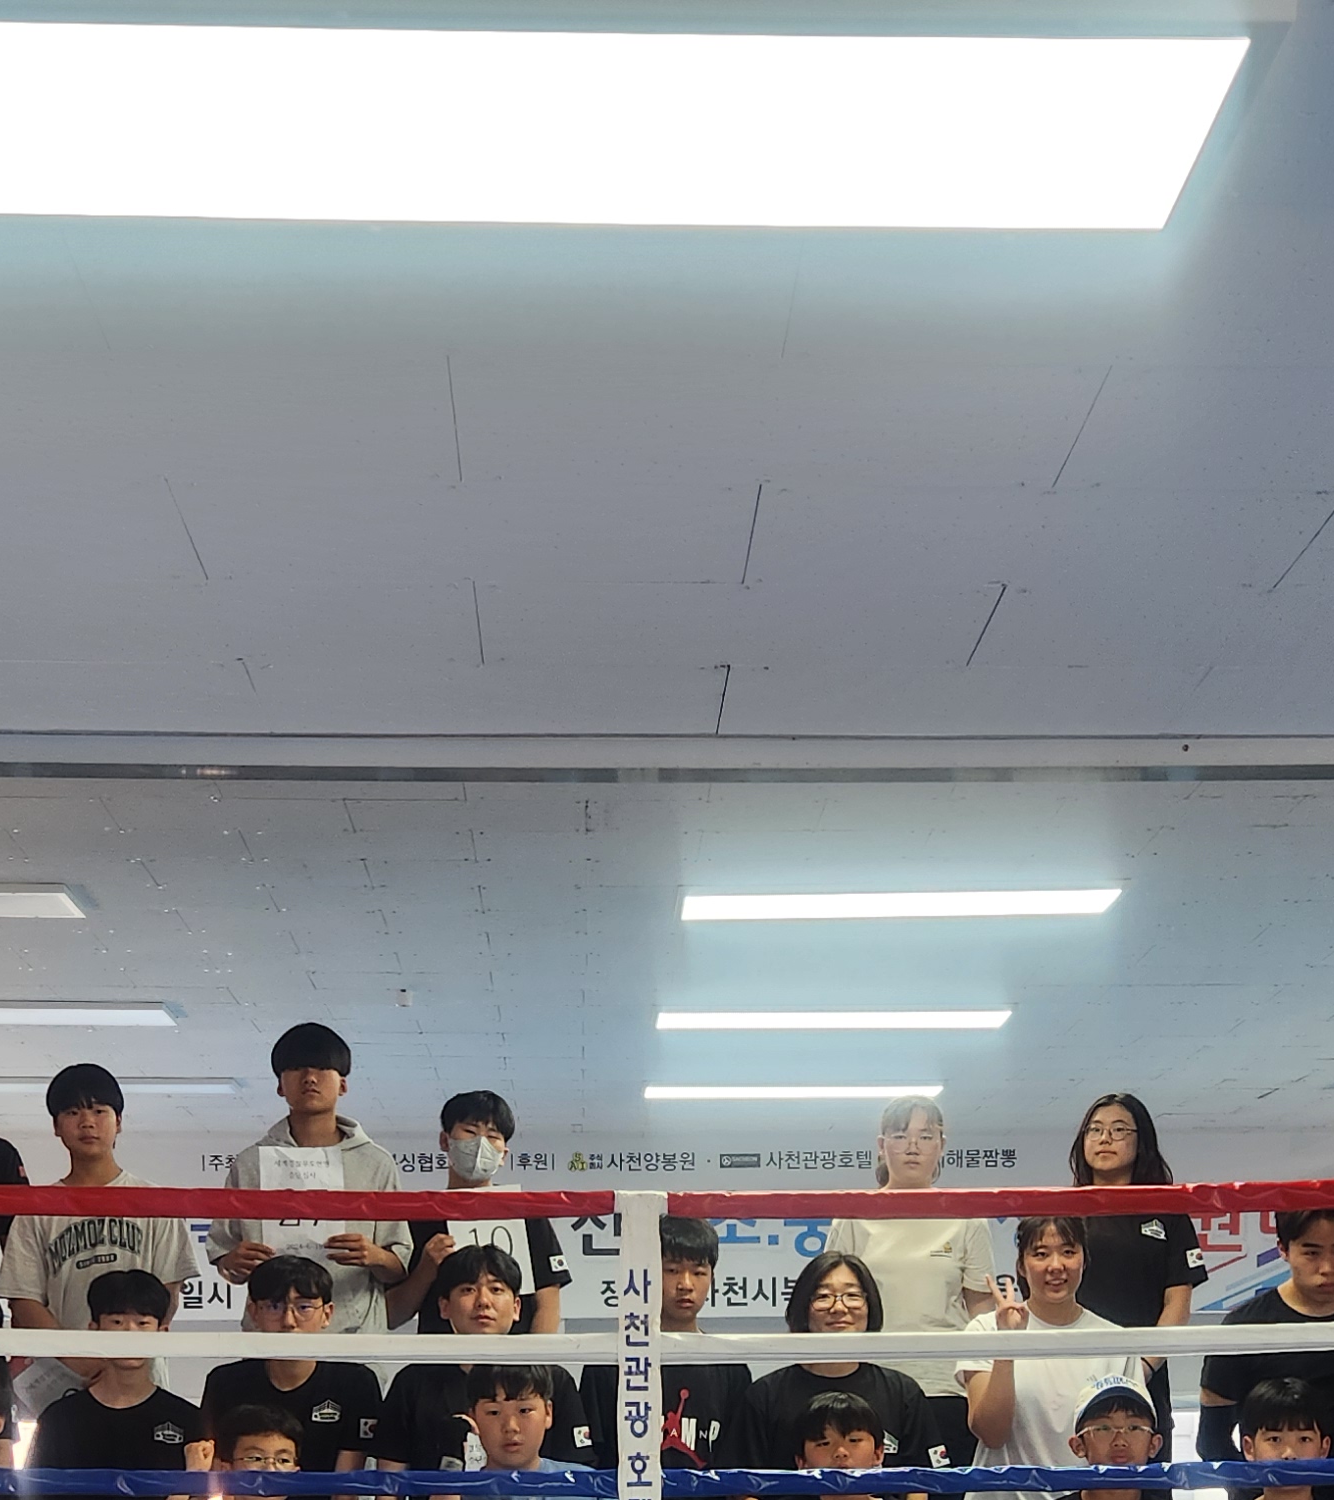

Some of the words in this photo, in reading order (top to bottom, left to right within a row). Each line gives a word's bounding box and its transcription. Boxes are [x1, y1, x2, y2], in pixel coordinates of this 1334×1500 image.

[606, 1151, 696, 1172] 사천양봉원
[765, 1149, 872, 1170] 사천관광호텔
[940, 1148, 1017, 1169] 해물짬뽕
